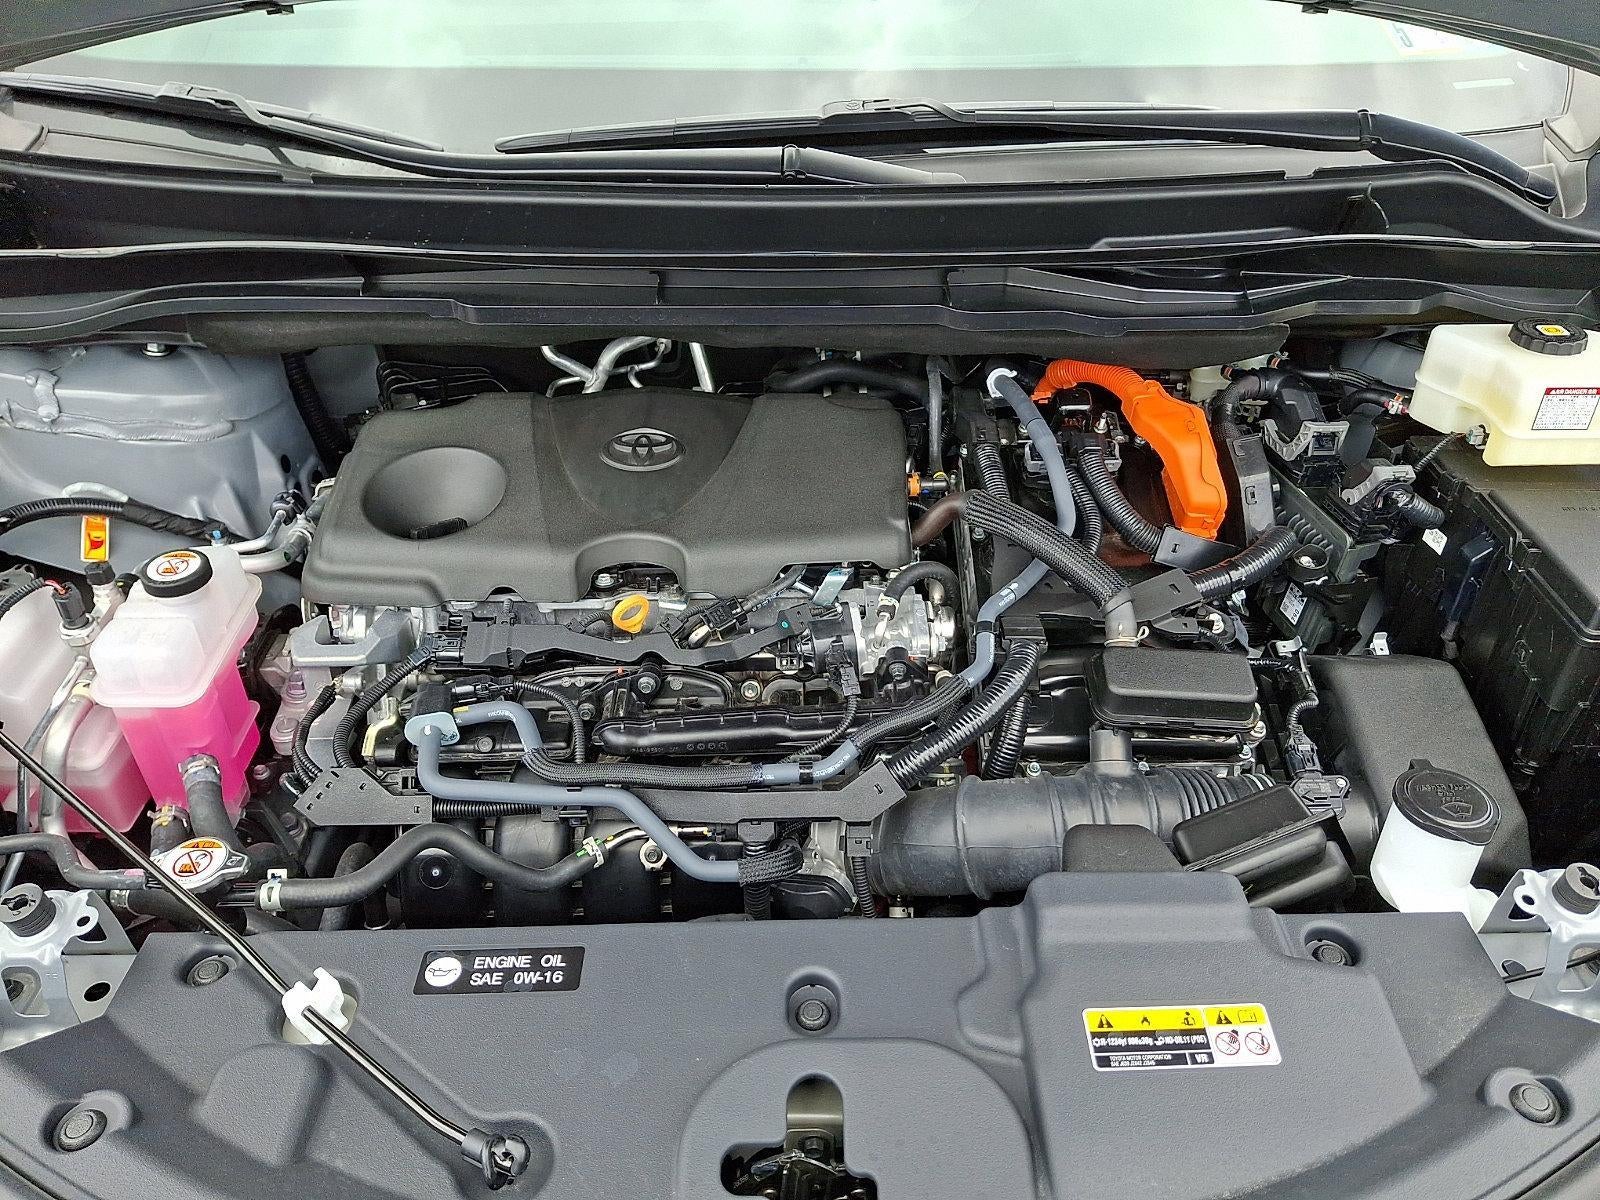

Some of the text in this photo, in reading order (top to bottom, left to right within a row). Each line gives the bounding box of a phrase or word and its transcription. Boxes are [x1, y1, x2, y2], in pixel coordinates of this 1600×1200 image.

[473, 954, 567, 969] ENGINE OIL
[469, 971, 564, 986] SAE 0W-16
